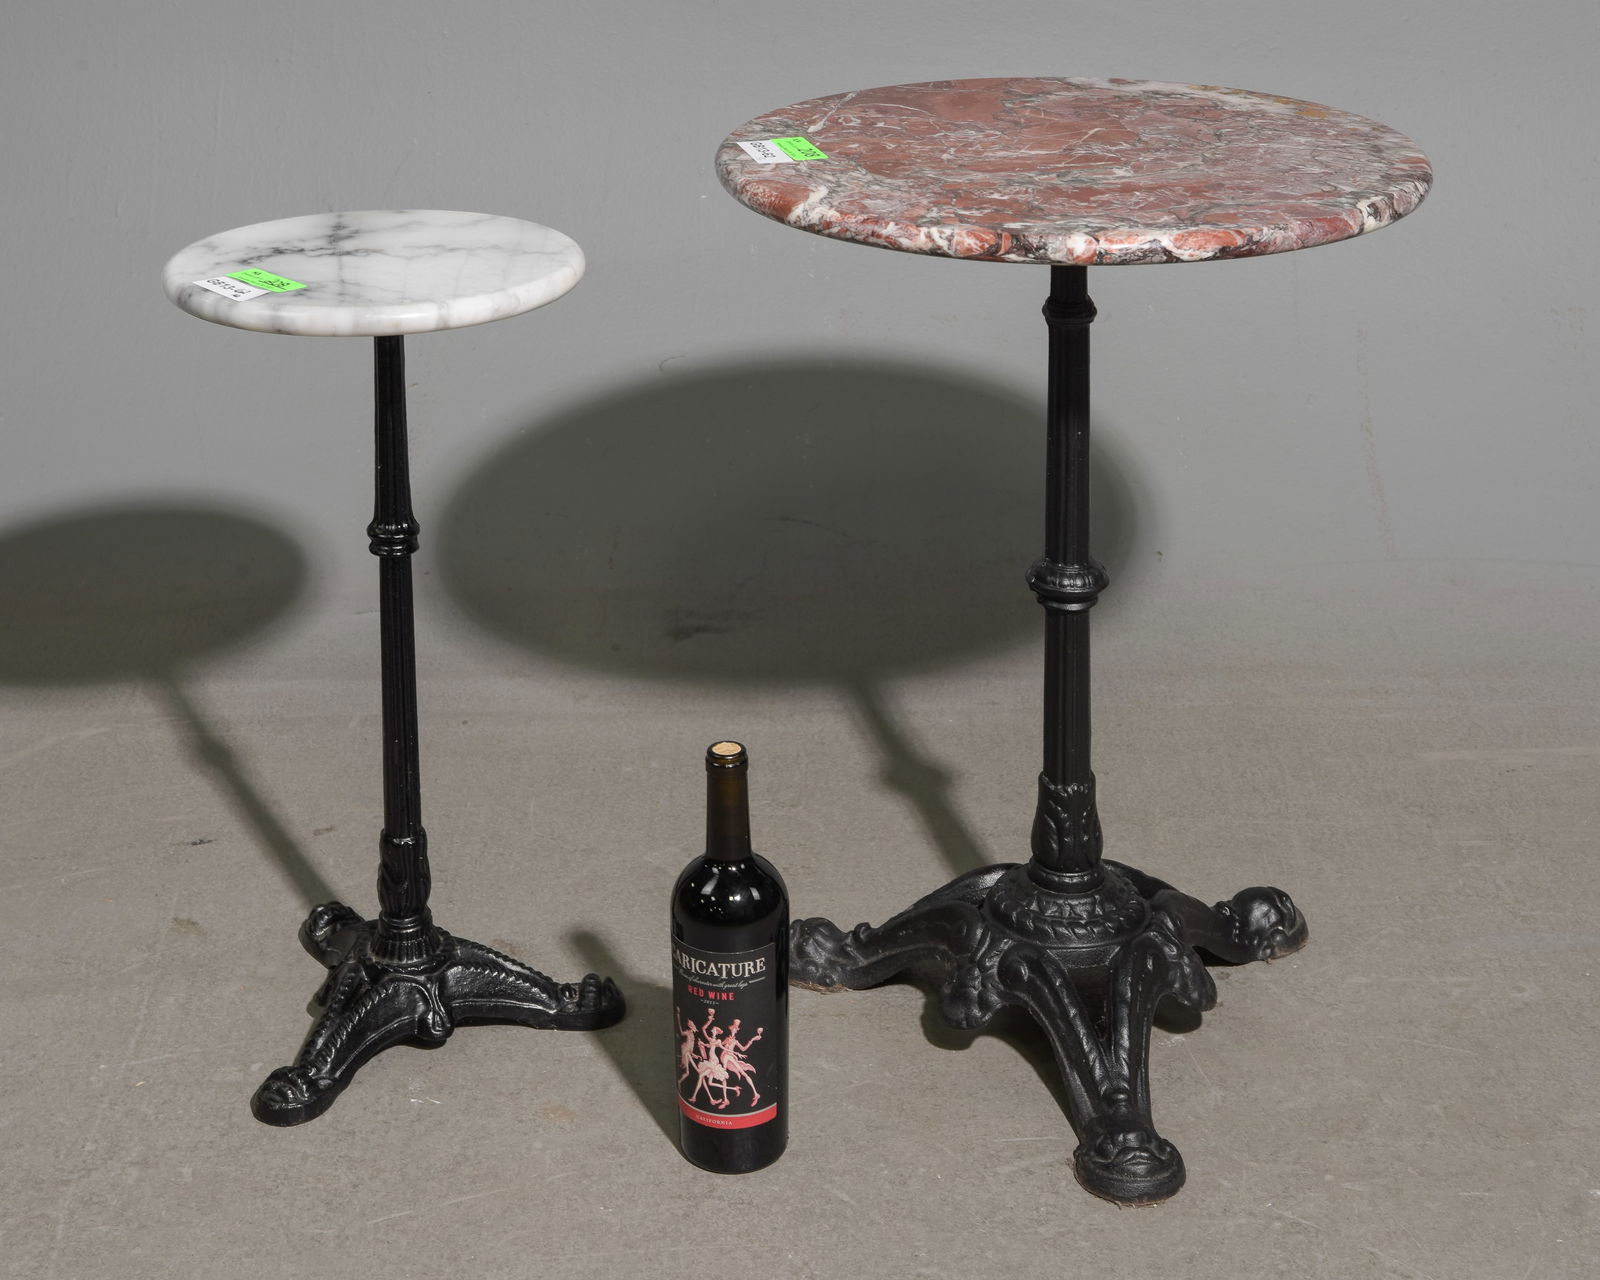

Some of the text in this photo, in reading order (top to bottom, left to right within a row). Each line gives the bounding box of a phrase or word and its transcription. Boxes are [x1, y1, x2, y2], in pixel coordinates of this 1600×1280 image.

[687, 984, 735, 1001] RED WINE
[696, 1114, 733, 1126] CALIFORNIA
